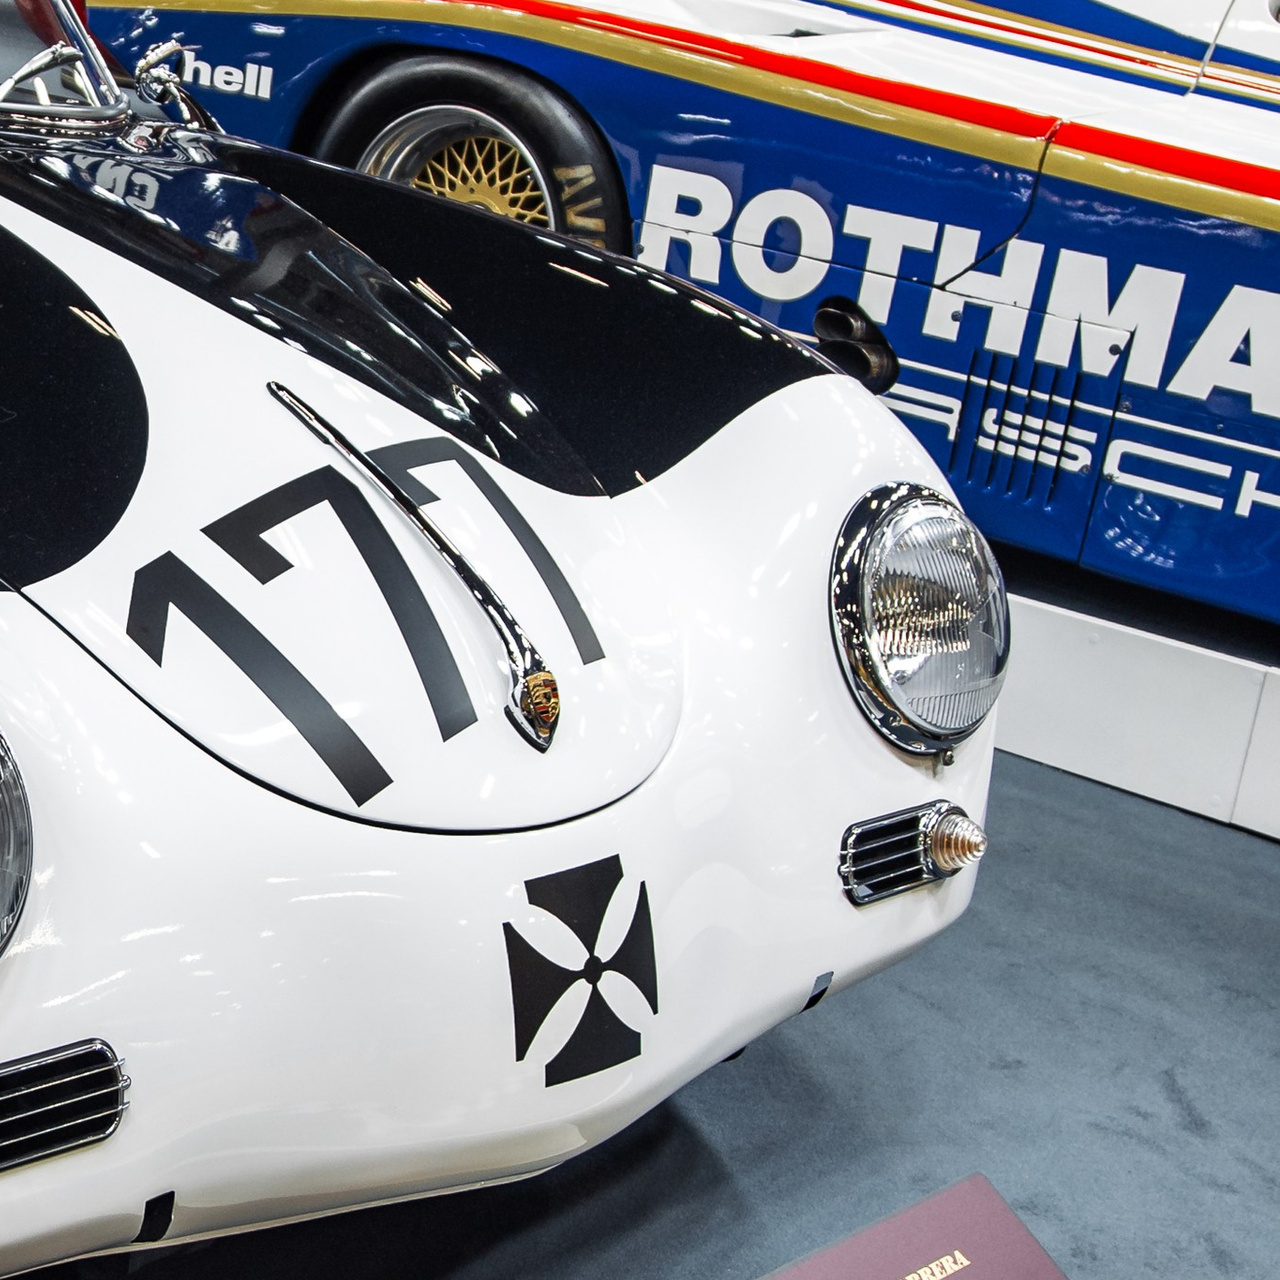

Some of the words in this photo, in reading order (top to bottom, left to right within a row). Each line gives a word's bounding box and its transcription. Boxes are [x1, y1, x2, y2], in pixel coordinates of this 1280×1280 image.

[183, 50, 273, 100] hell
[639, 163, 1280, 418] ROTHMA
[125, 435, 606, 808] 177
